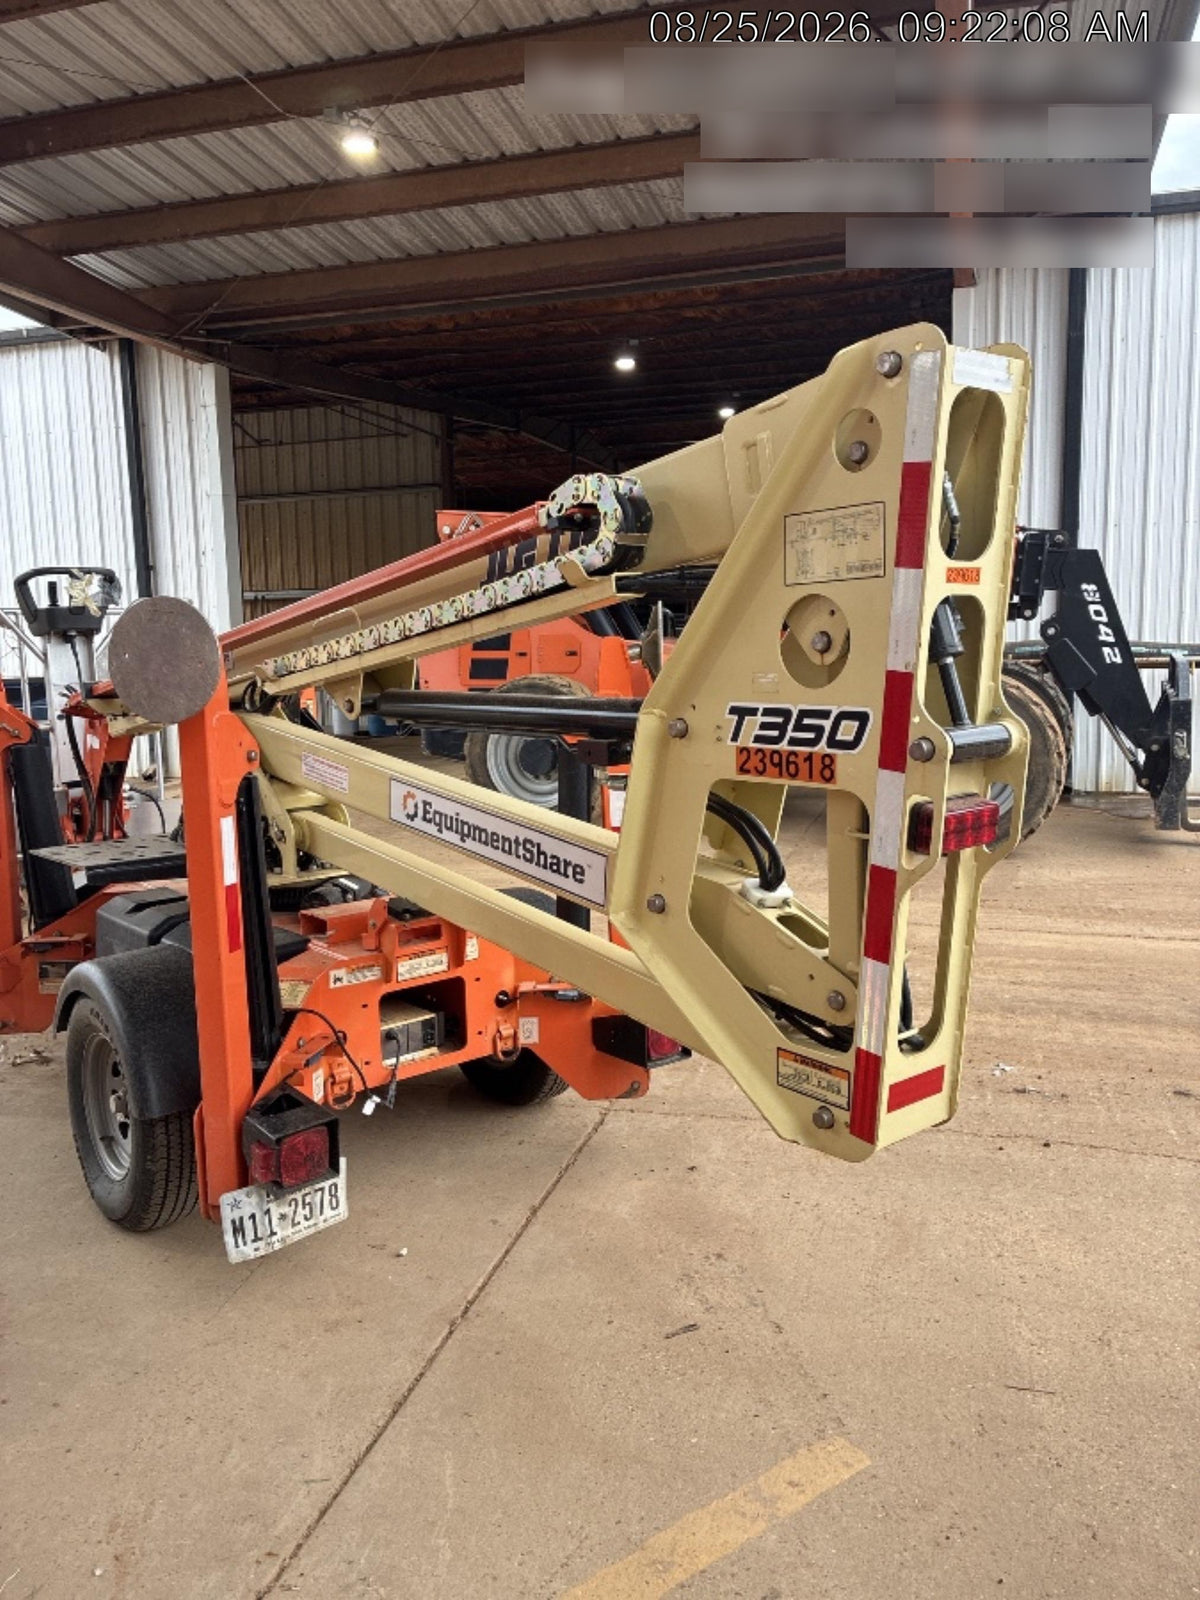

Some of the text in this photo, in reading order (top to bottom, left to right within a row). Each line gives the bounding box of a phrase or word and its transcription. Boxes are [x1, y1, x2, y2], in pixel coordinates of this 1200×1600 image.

[1081, 582, 1123, 664] 8042
[728, 705, 871, 751] T350
[738, 746, 835, 783] 239618
[421, 799, 586, 884] EquipmentShare
